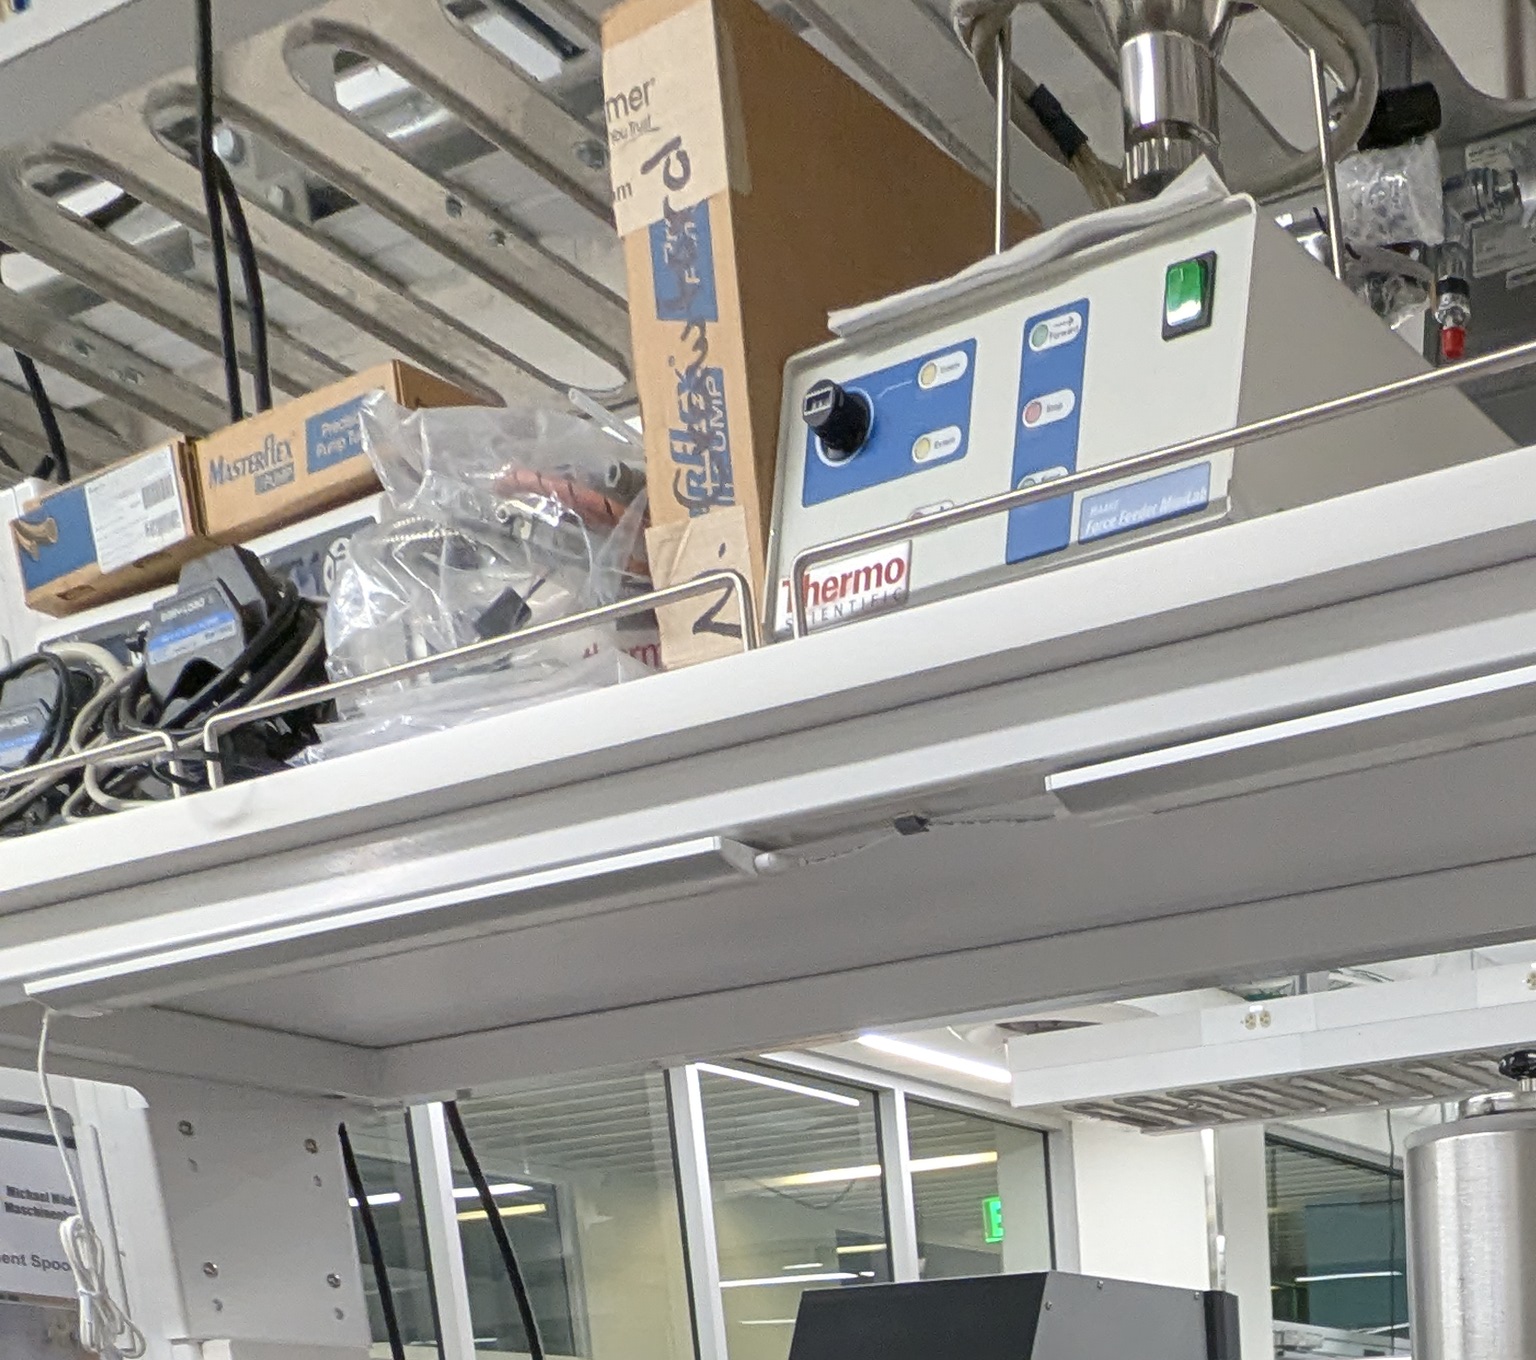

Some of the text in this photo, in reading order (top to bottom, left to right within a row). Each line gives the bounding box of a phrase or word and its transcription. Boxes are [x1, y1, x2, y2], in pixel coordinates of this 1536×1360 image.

[784, 587, 904, 633] SIENTIFIC
[0, 1254, 72, 1272] ent Spoo
